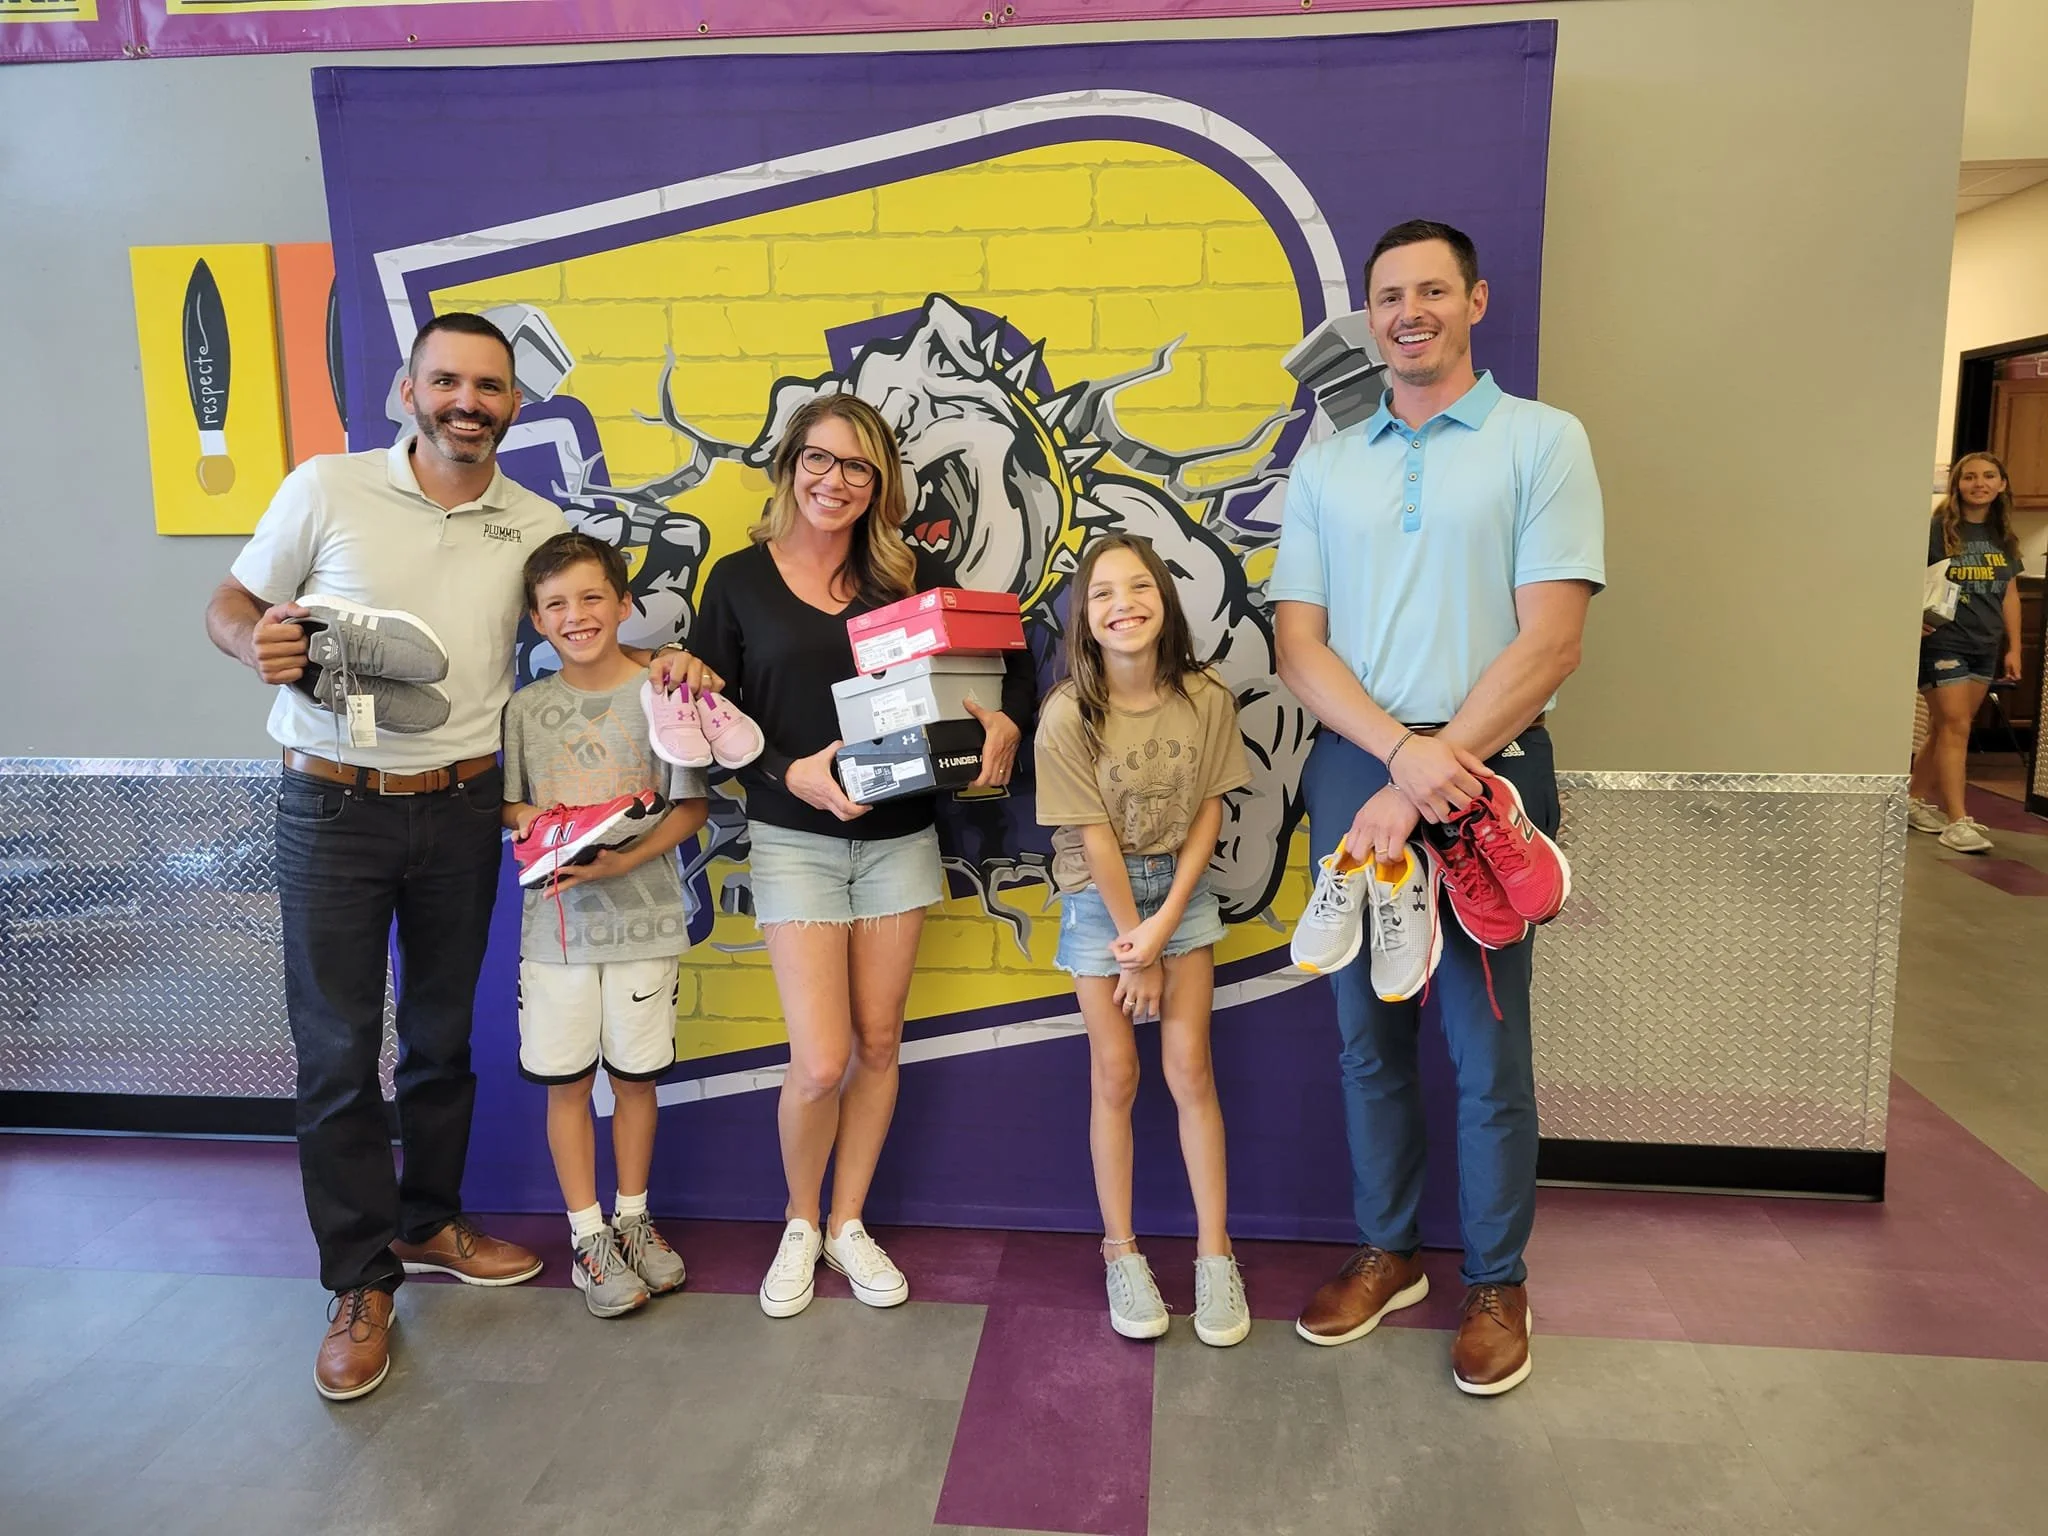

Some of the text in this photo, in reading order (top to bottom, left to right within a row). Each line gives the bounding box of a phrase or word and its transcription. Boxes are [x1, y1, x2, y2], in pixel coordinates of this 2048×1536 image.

[483, 523, 522, 543] PLUMMER
[1984, 553, 2008, 567] THE
[1949, 566, 1996, 580] FUTURE
[949, 755, 978, 767] UNDER
[1501, 750, 1525, 758] adidas
